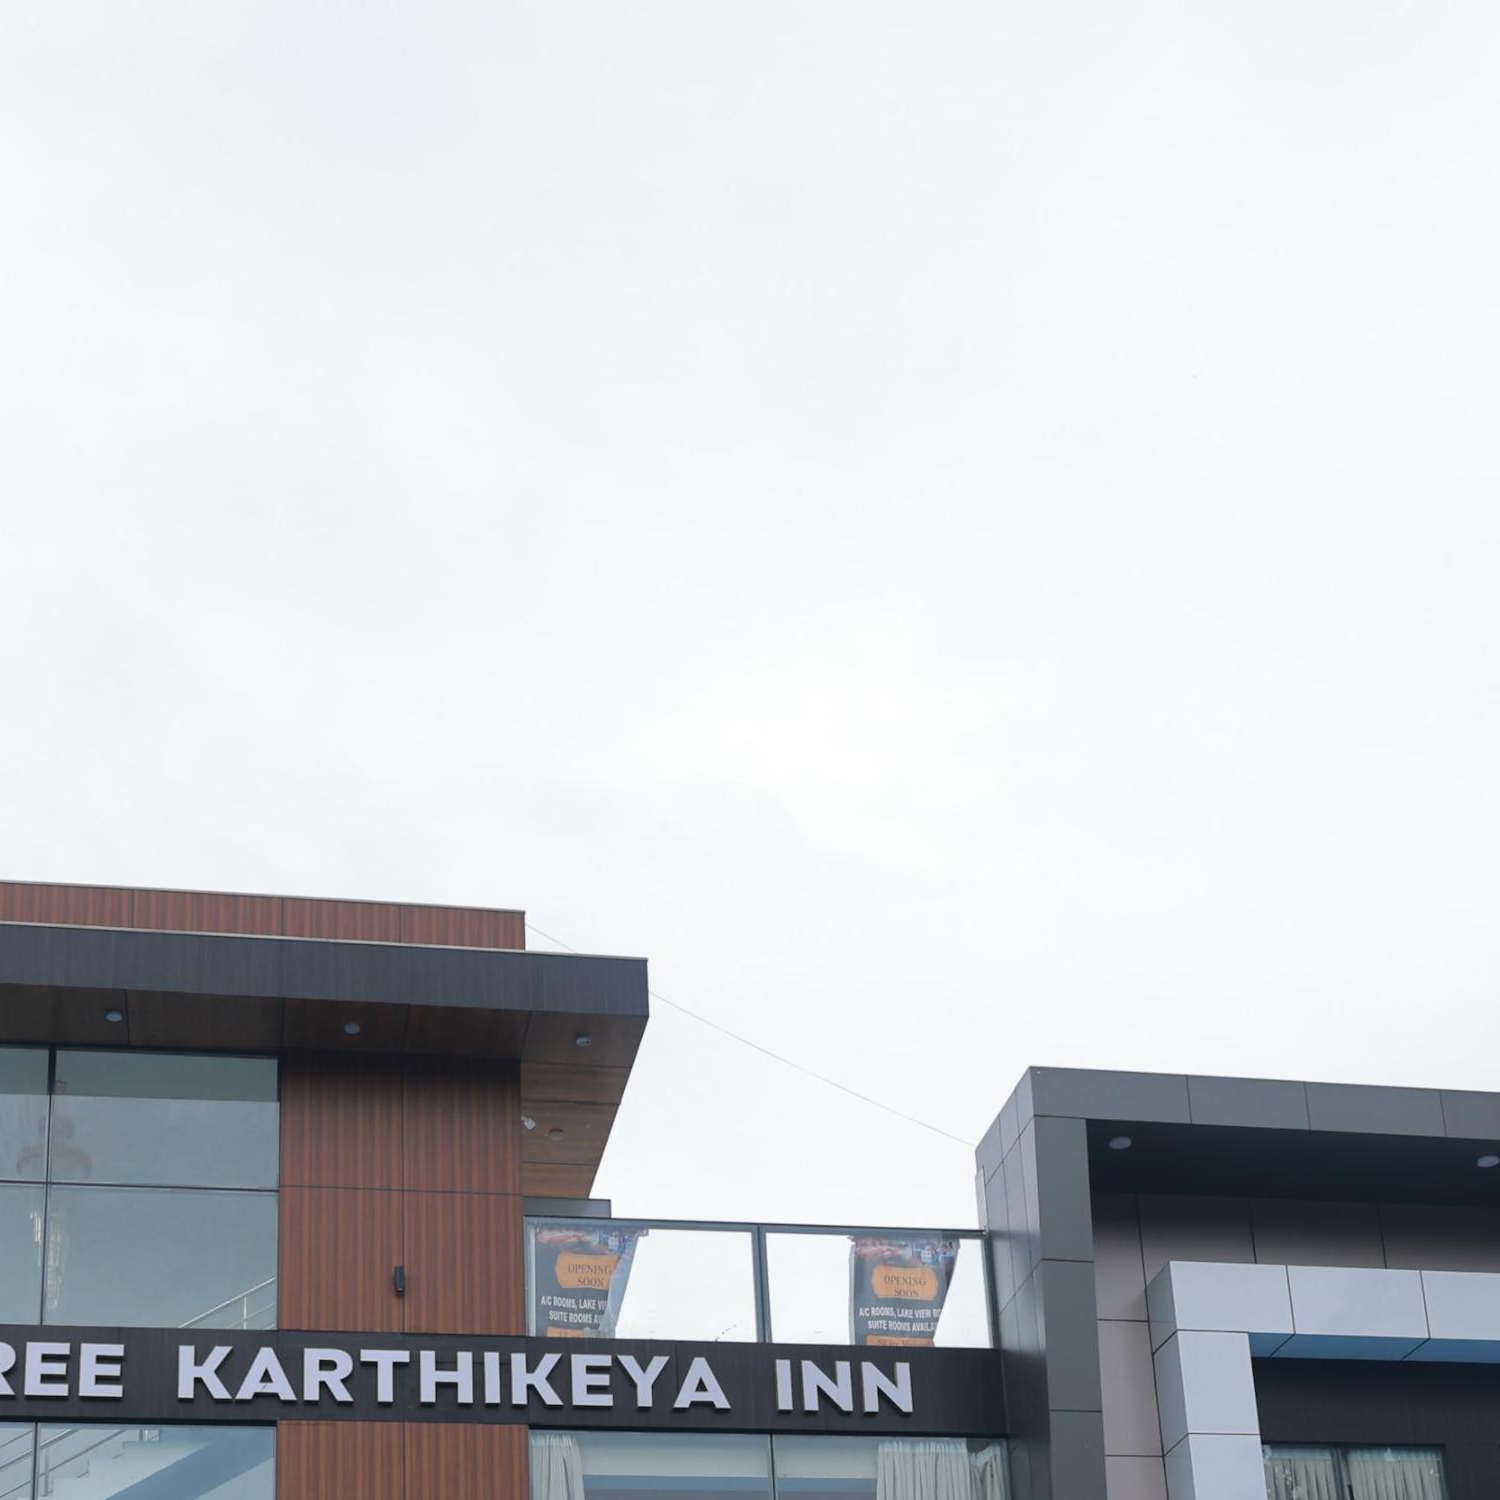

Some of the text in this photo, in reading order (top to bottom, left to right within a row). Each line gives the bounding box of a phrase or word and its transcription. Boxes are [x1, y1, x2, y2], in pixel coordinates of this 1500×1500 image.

[577, 1278, 604, 1287] SOON
[579, 1298, 597, 1310] LAKE
[548, 1310, 568, 1322] SUITE
[568, 1313, 593, 1324] ROOMS
[897, 1309, 913, 1319] LAKE
[867, 1320, 888, 1330] SUITE
[888, 1321, 911, 1332] ROOMS
[177, 1344, 732, 1410] KARTHIKEYA
[775, 1358, 914, 1414] INN
